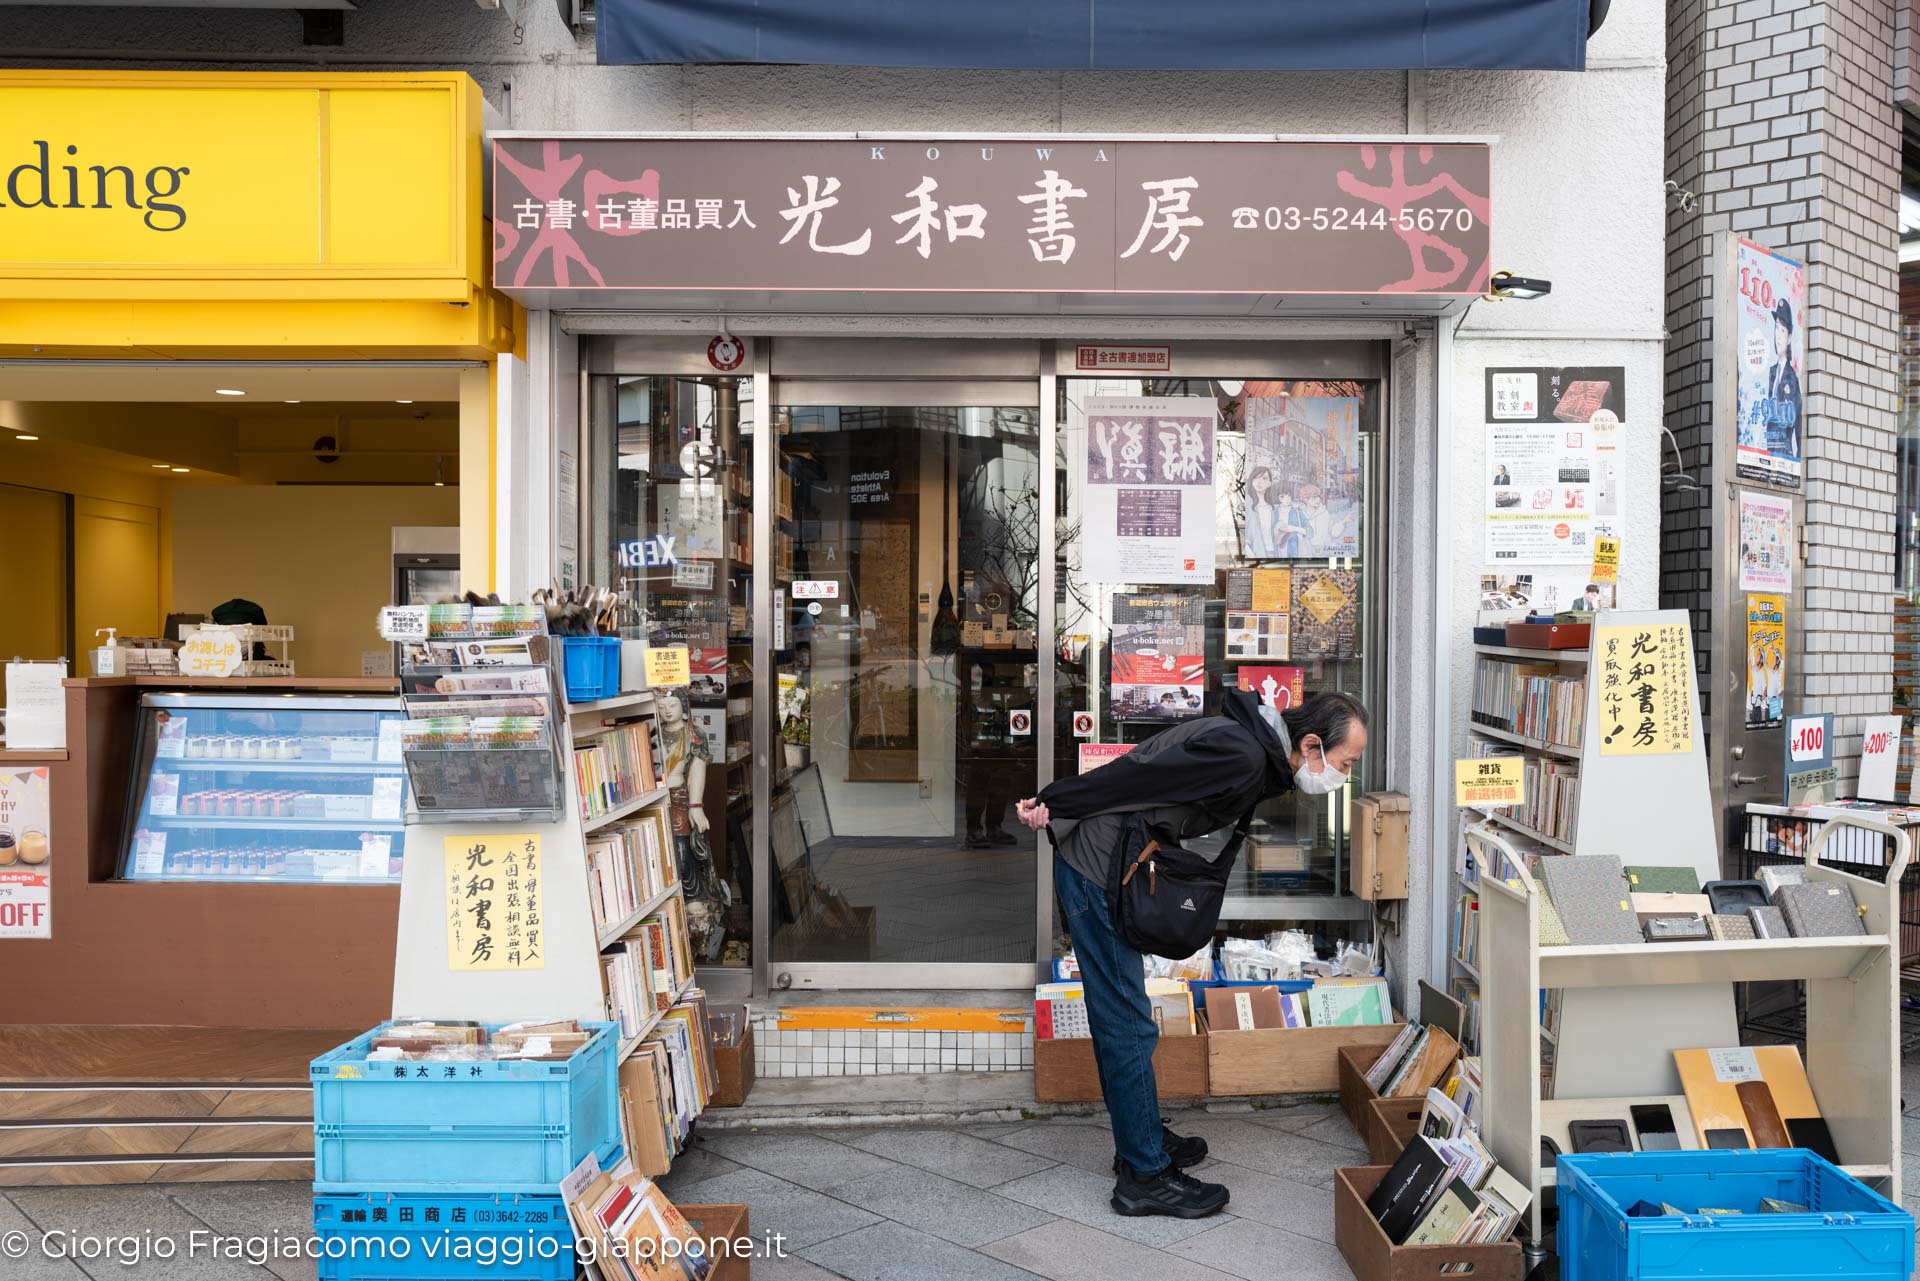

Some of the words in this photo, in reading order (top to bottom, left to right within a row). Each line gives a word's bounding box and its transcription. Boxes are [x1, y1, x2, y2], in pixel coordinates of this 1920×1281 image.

[0, 141, 190, 231] ding
[779, 169, 1204, 265] 光和書房
[1265, 206, 1473, 232] 03-5244-5670
[1099, 351, 1166, 364] 全古書連加盟店
[191, 658, 226, 672] コチラ
[1627, 632, 1658, 747] 光和書房
[1792, 726, 1823, 752] ¥100
[1864, 732, 1887, 754] ¥200
[0, 902, 46, 927] OFF
[466, 844, 494, 964] 光和書房
[473, 1209, 548, 1224] (03)3642-2289
